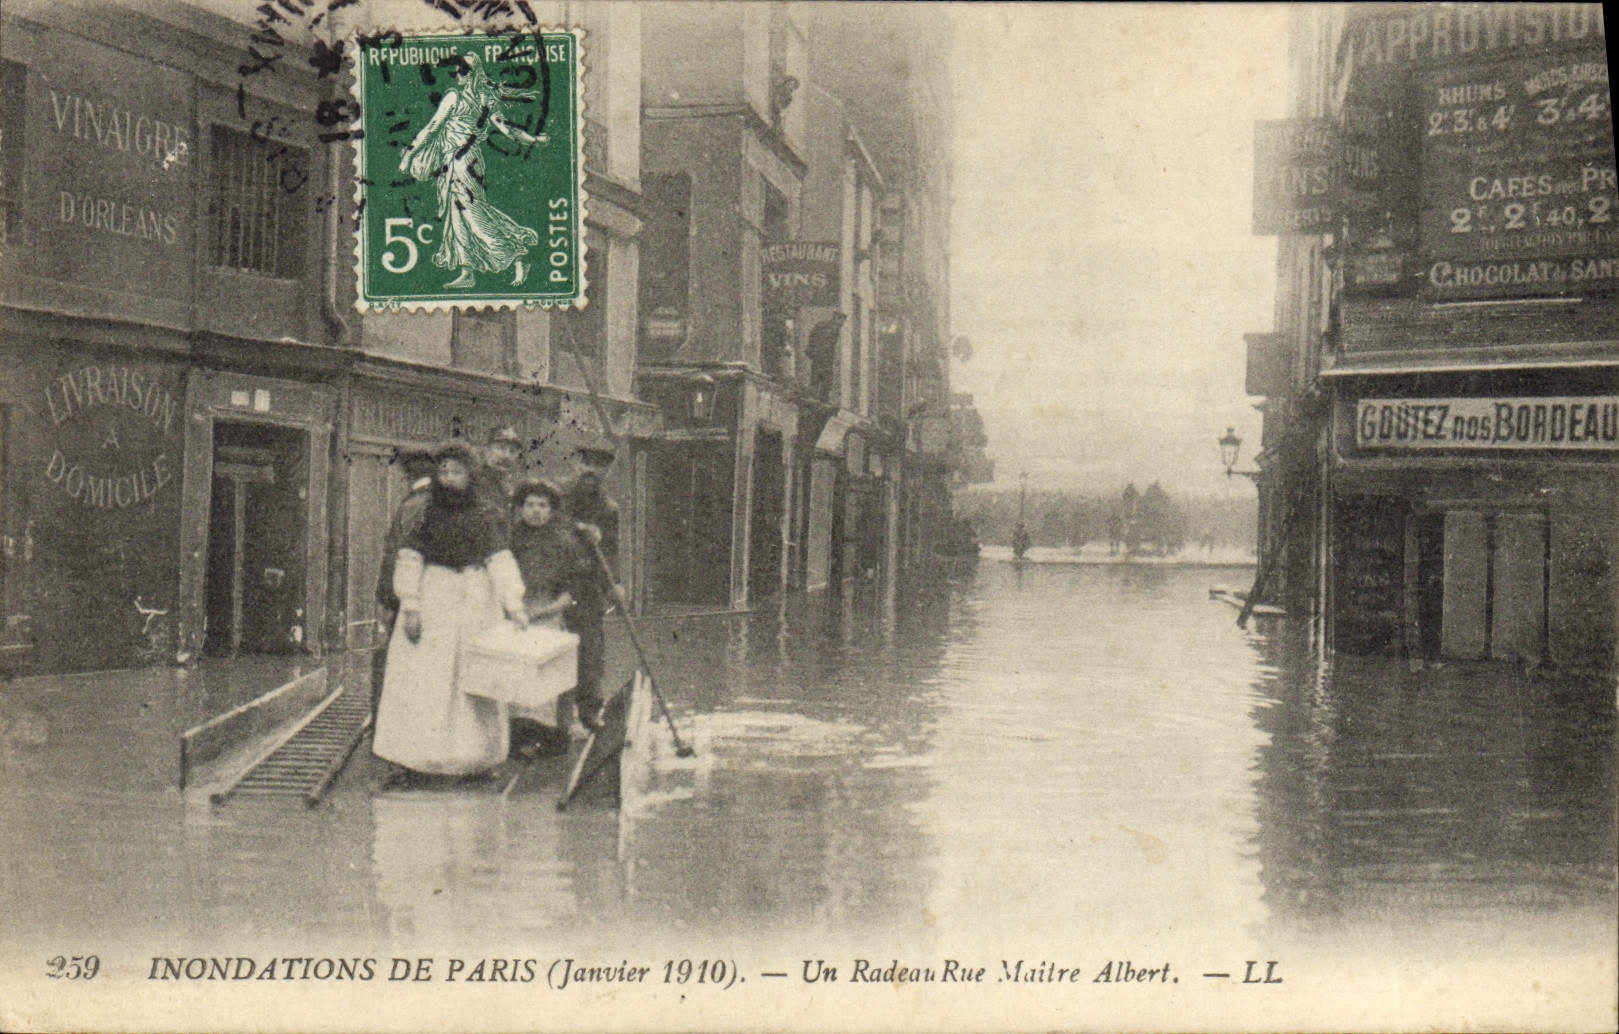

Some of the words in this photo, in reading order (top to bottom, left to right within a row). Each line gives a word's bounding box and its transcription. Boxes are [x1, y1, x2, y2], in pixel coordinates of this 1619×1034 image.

[1438, 80, 1506, 105] RHUMS
[50, 89, 190, 166] VINAIGRE
[549, 197, 569, 283] POSTES
[761, 243, 839, 264] RESTAURANT
[769, 271, 830, 289] VINS
[45, 365, 178, 435] LIVRAISON
[46, 450, 171, 509] DOMICILE
